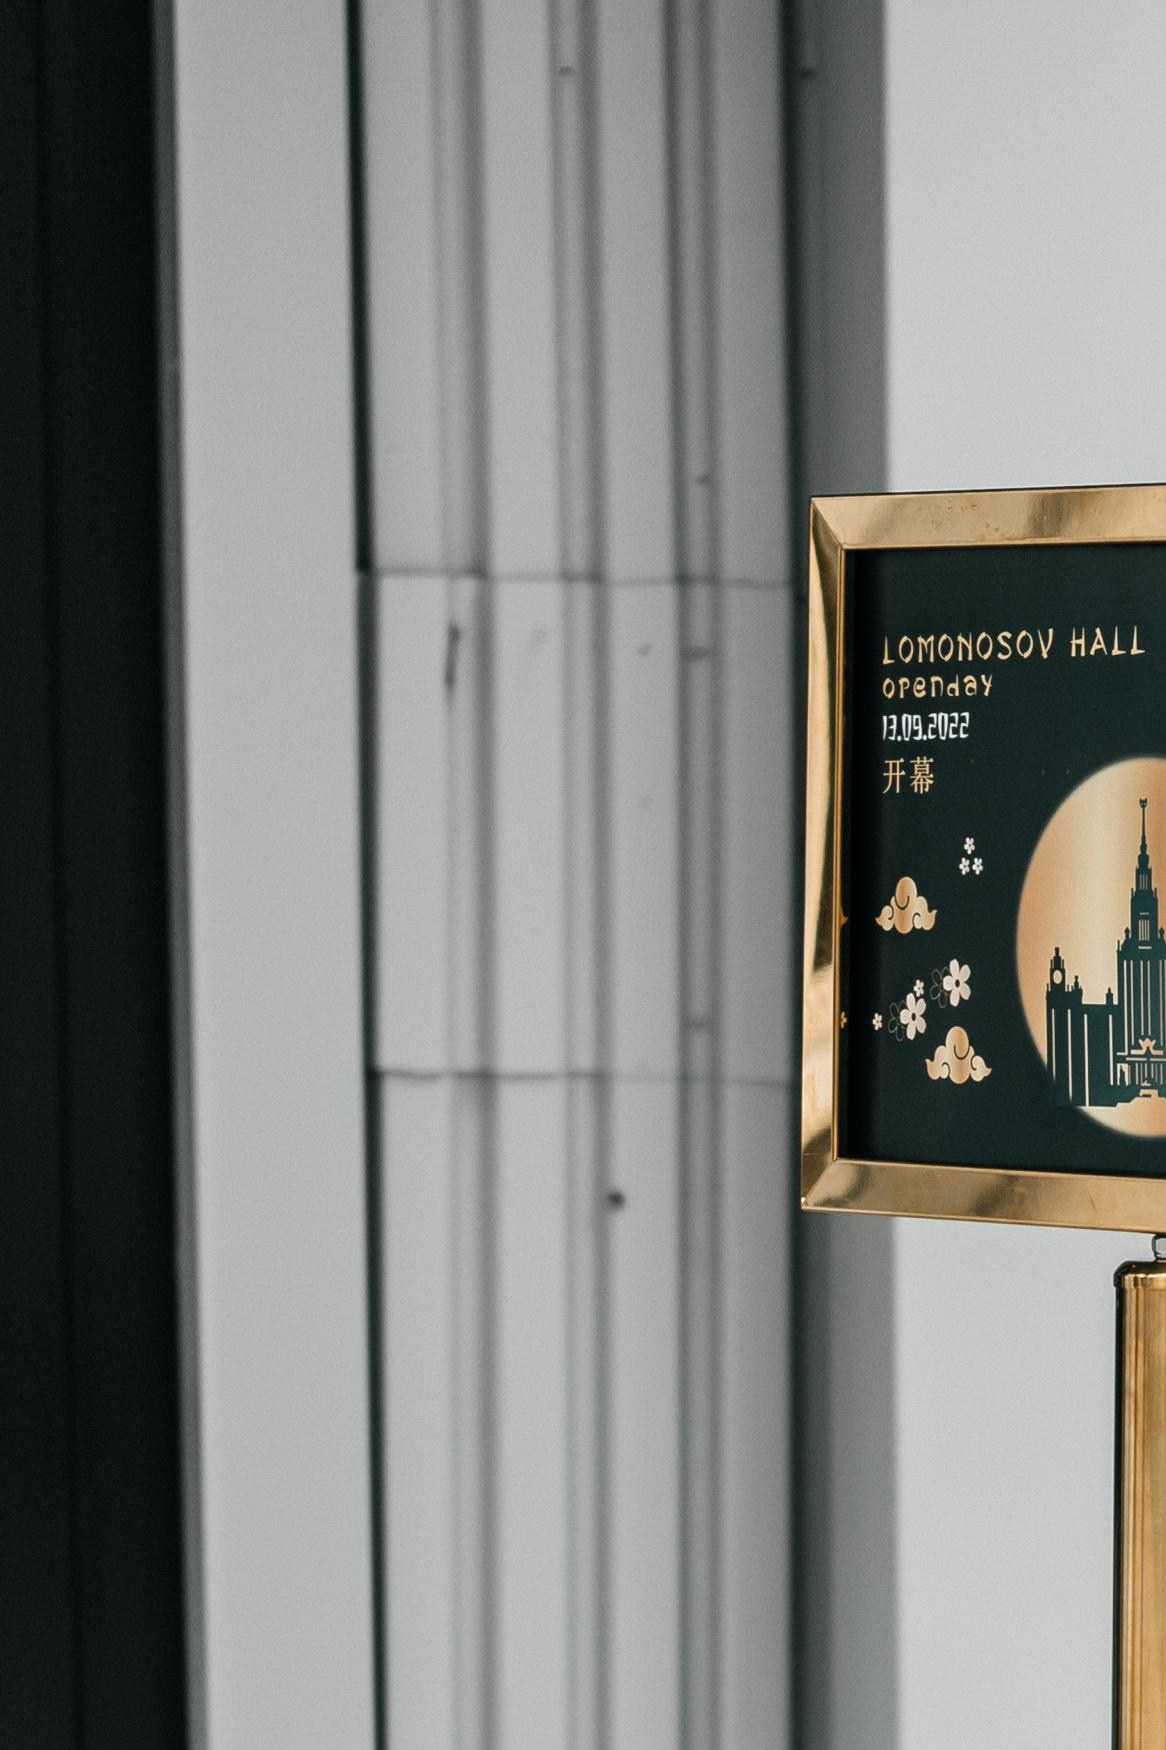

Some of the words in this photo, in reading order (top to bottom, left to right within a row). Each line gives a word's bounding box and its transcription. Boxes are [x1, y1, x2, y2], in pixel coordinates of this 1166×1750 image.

[882, 627, 1055, 665] LOMONOSOV
[1070, 625, 1146, 657] HALL
[882, 711, 970, 742] 13.09.2022
[882, 755, 935, 795] 开幕
